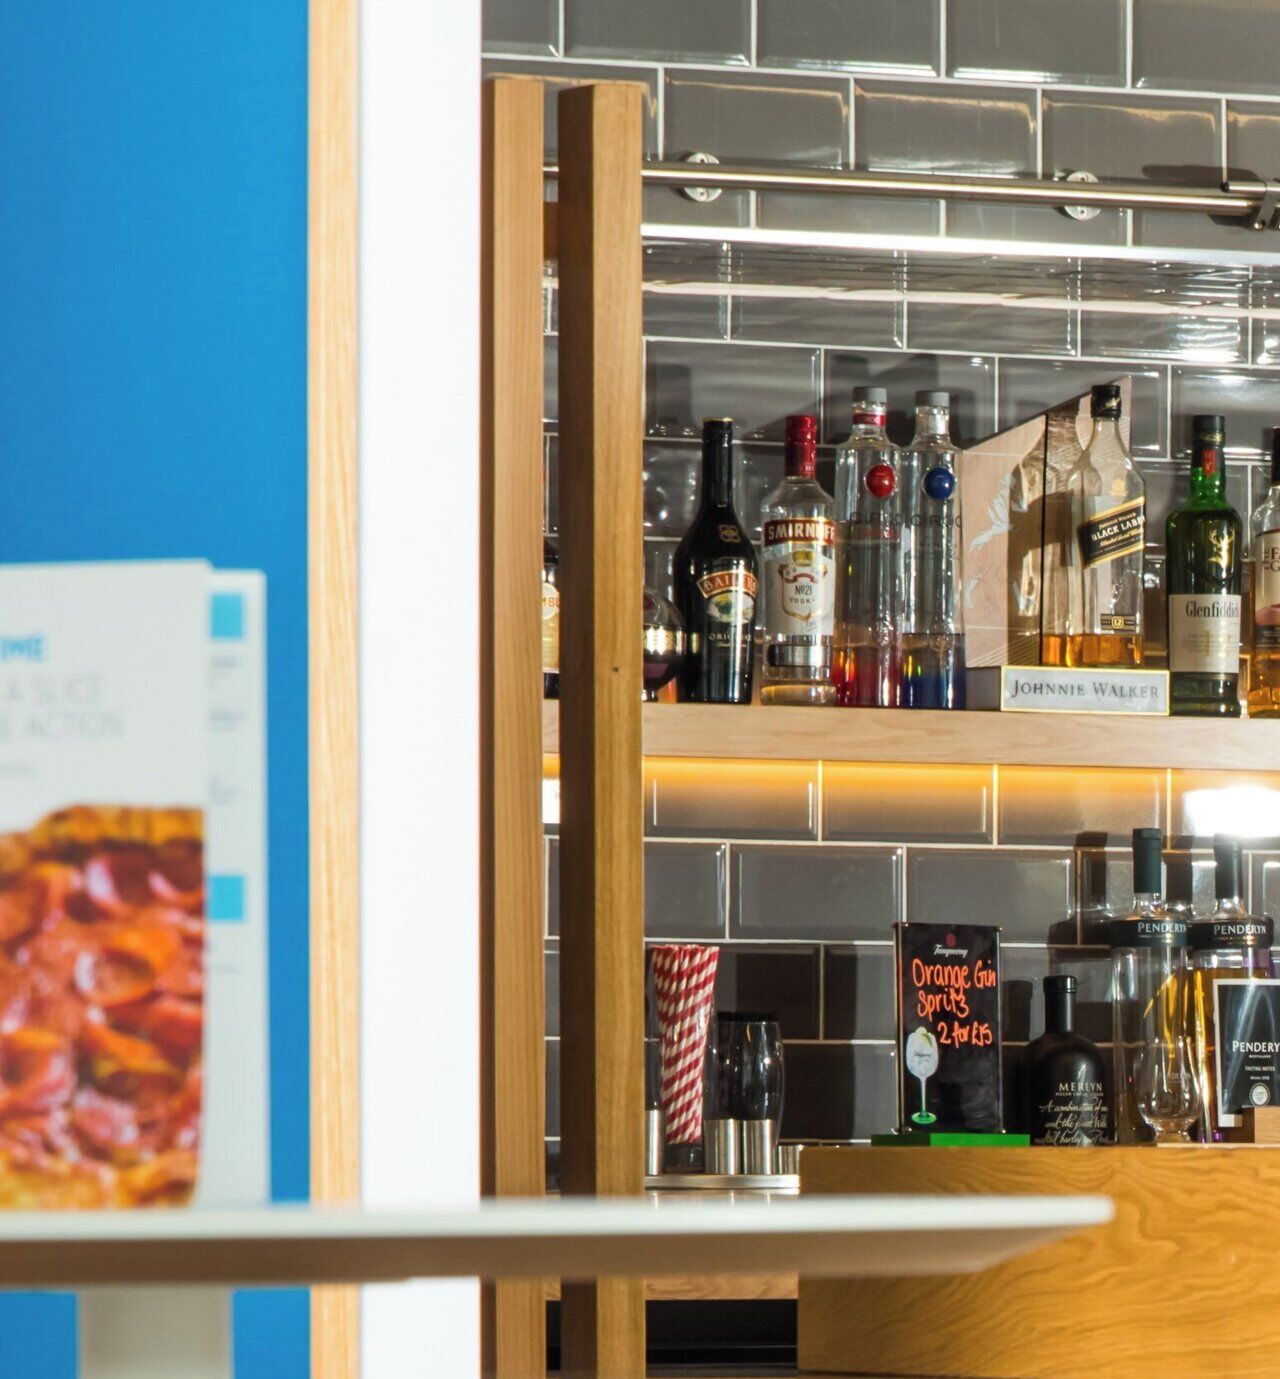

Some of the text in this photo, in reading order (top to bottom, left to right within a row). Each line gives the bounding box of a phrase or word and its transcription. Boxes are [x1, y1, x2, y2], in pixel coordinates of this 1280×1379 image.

[702, 574, 758, 592] BAILYS
[1011, 679, 1159, 699] JOHNNIE WALKER
[1138, 922, 1187, 934] PENDERYN
[1213, 924, 1267, 936] PENDERYN
[934, 944, 968, 958] Tanqueray
[912, 958, 996, 989] Orange Gin
[938, 1021, 993, 1049] 2 for £15
[1059, 1082, 1102, 1092] MERLYN
